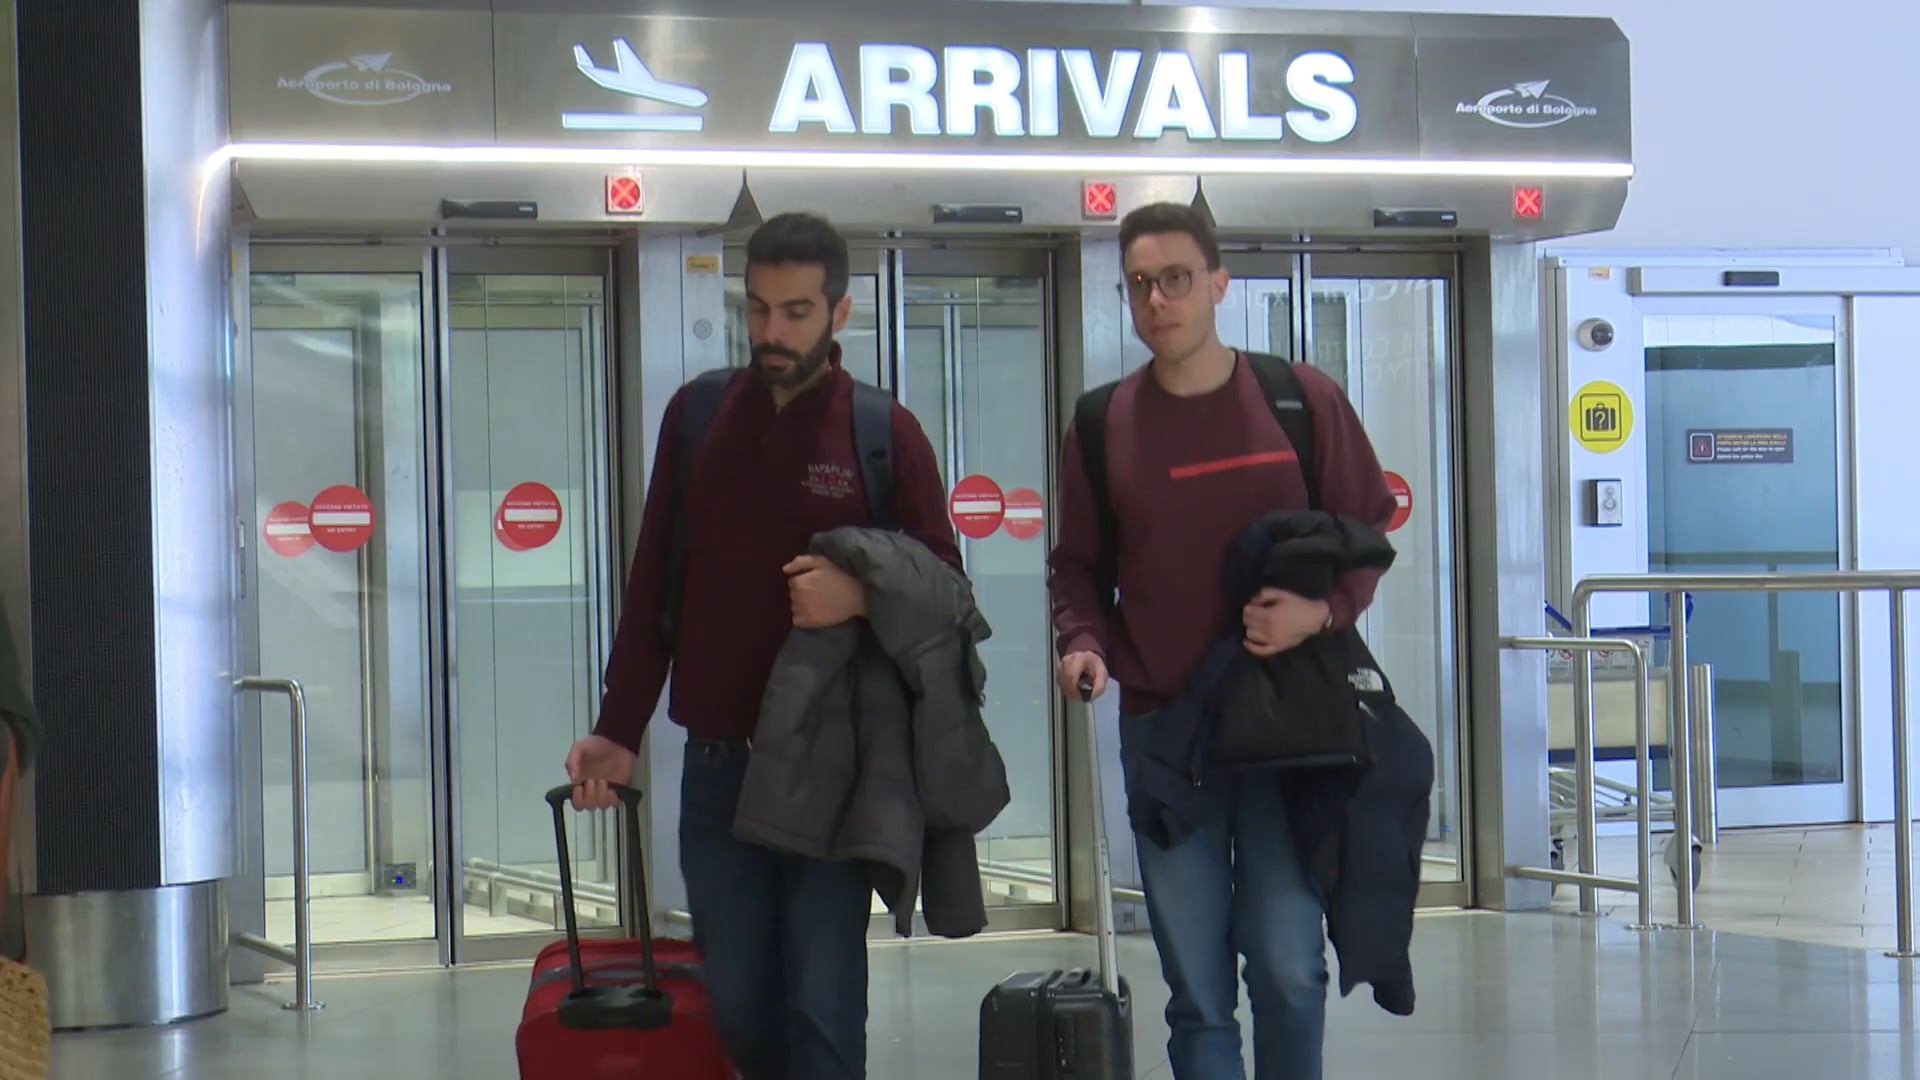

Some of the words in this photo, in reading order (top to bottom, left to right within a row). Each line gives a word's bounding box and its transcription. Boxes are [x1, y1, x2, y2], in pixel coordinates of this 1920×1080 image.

[276, 76, 359, 92] Aeroporto
[364, 78, 380, 91] di
[384, 79, 452, 94] Bologna
[768, 42, 1359, 142] ARRIVALS
[1455, 101, 1523, 116] Aeroporto
[1526, 103, 1539, 114] di
[1543, 104, 1598, 117] Bologna
